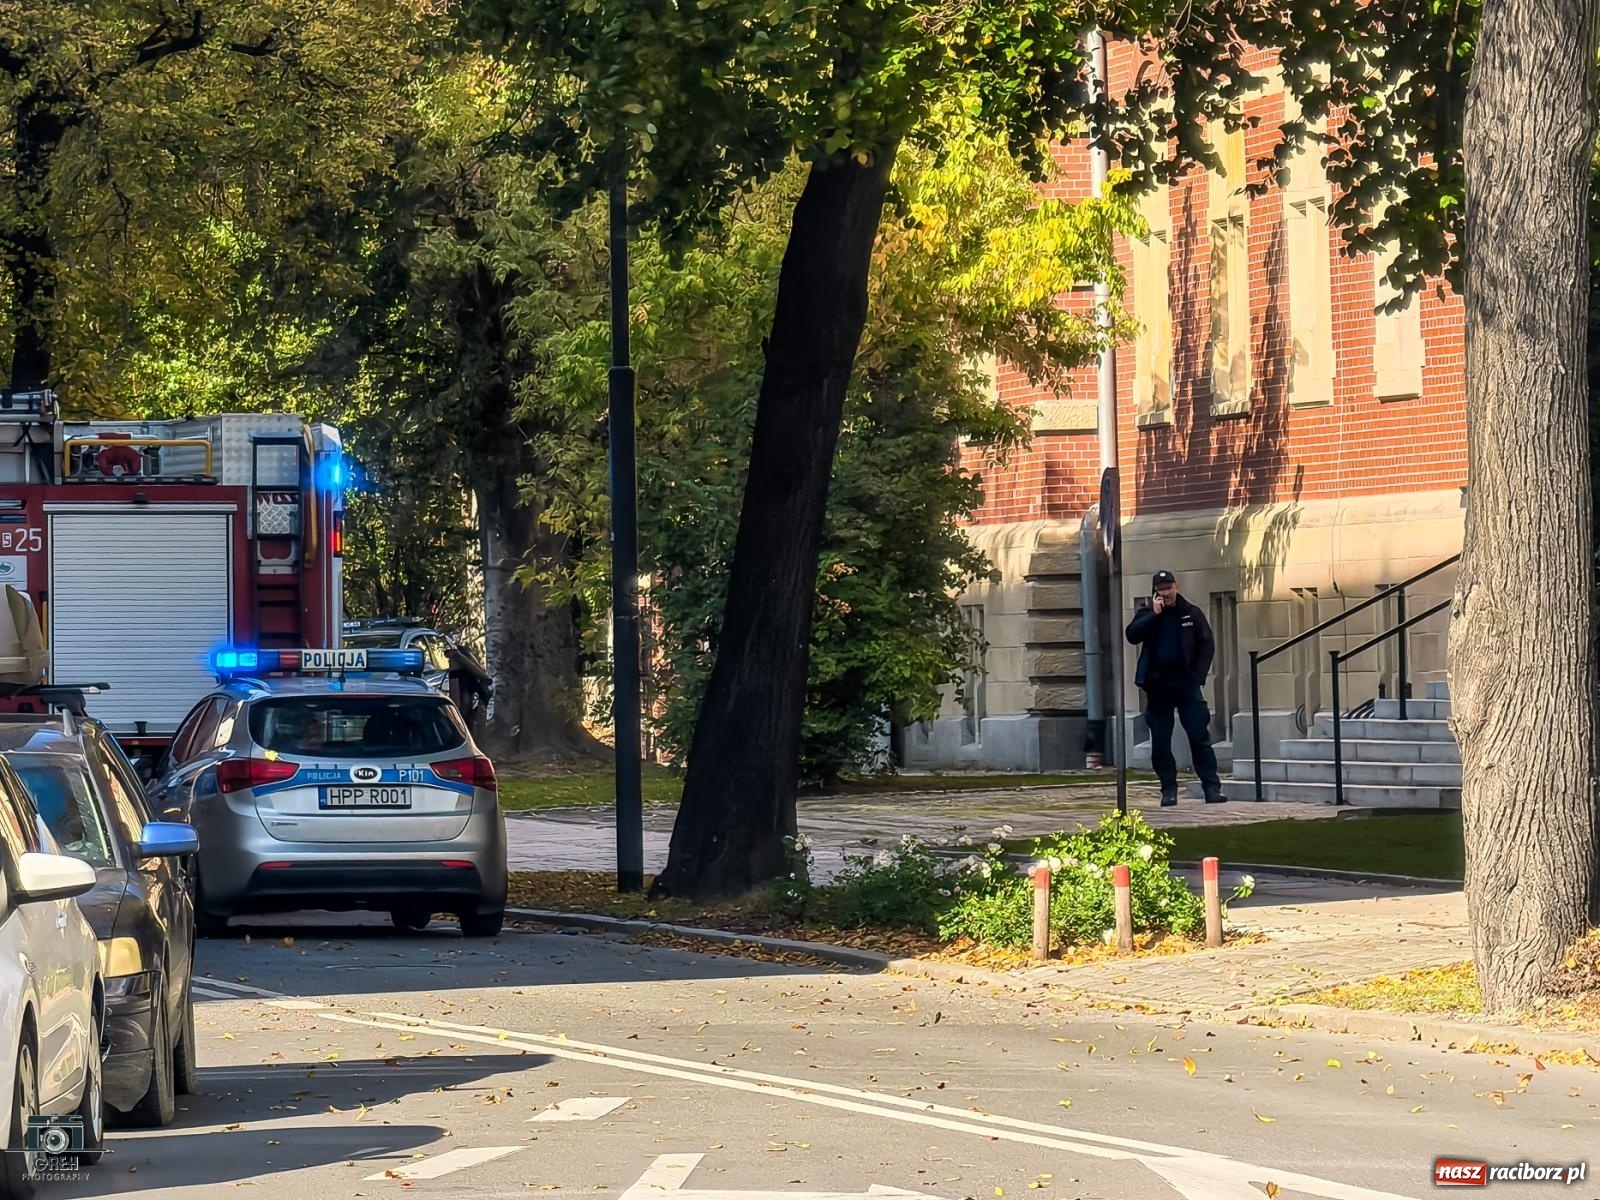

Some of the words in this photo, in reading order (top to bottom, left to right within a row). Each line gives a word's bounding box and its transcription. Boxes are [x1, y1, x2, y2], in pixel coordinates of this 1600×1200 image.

[15, 528, 42, 552] 25
[303, 652, 366, 667] POLICJA
[399, 769, 424, 782] P101
[330, 788, 364, 805] HPP
[370, 788, 407, 804] R001
